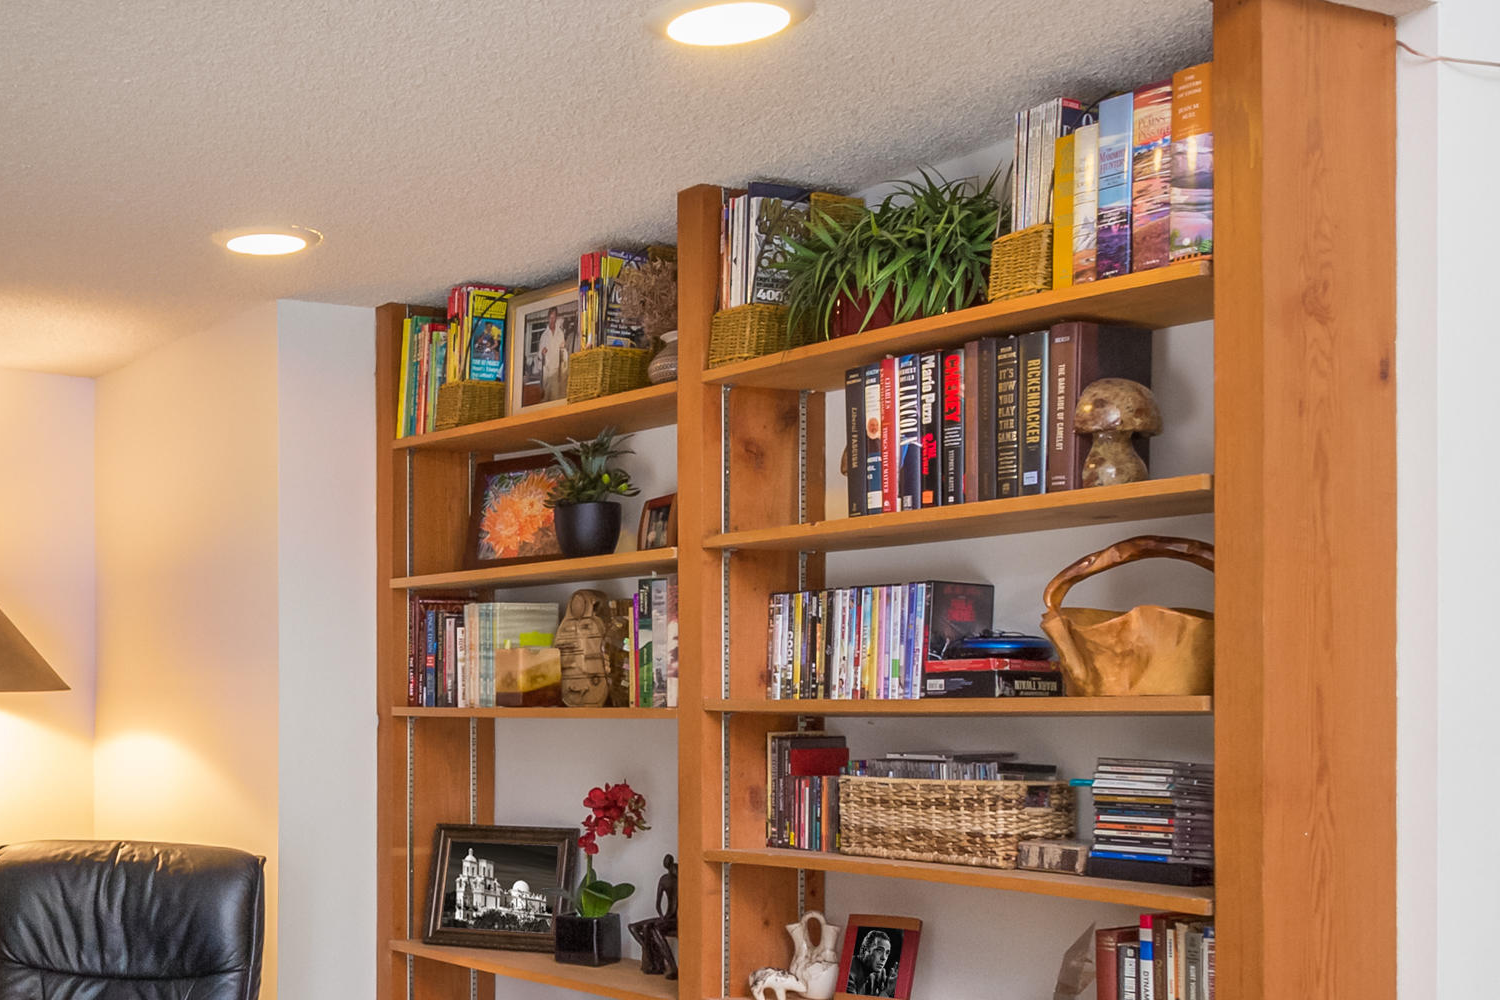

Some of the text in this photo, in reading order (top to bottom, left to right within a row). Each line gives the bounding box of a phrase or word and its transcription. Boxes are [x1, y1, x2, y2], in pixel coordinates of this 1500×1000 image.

[1058, 364, 1066, 376] THE
[921, 355, 935, 425] Mario Puzo
[944, 354, 961, 422] CHENEY
[1026, 358, 1041, 444] RICKENBACKER
[900, 385, 922, 447] LINCOLN
[1057, 396, 1065, 410] SIDE
[1057, 412, 1064, 420] OF
[1056, 422, 1064, 450] CAMELOT
[1189, 965, 1197, 980] KURT
